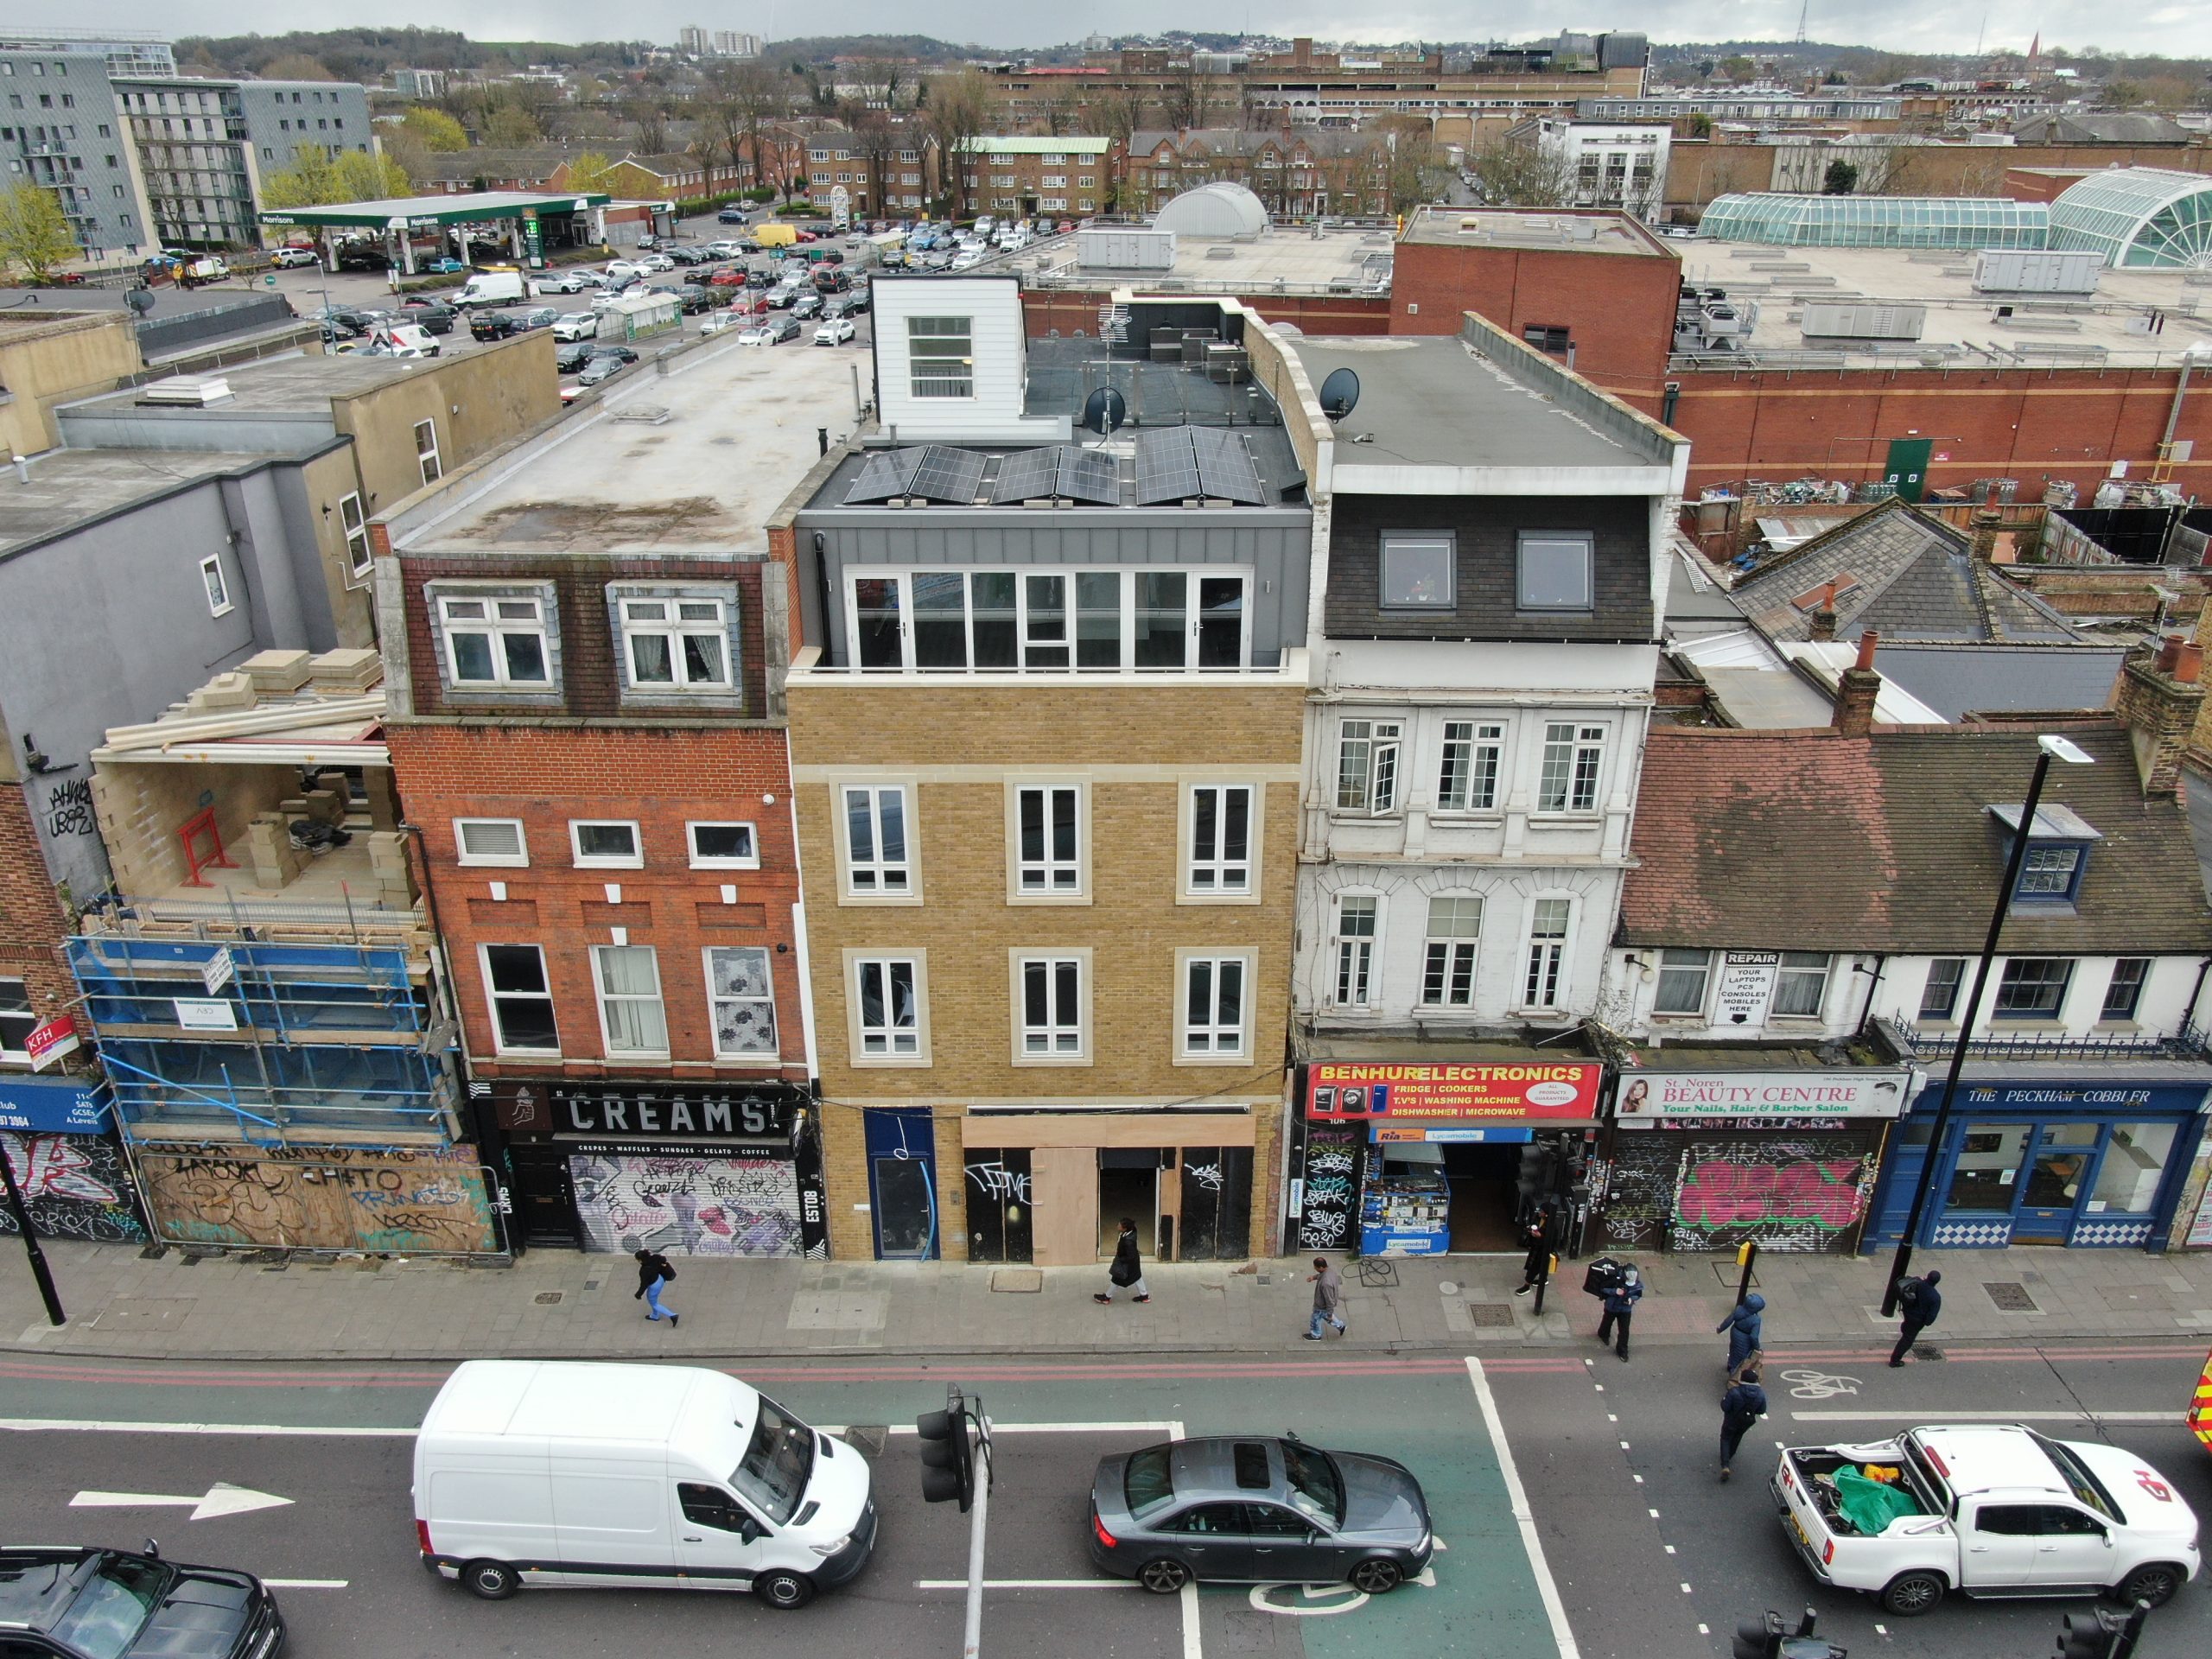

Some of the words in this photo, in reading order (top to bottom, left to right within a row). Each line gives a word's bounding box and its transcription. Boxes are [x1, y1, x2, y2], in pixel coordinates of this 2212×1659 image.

[410, 216, 438, 226] Morrisons
[1728, 954, 1777, 963] REPAIR
[28, 1028, 53, 1050] KFH
[1665, 1078, 1681, 1087] St.
[1686, 1078, 1724, 1087] Noren
[1662, 1088, 1758, 1102] BEAUTY
[1763, 1088, 1858, 1102] CENTRE
[1968, 1090, 1997, 1102] THE
[2005, 1090, 2074, 1102] PECKHAM
[0, 1101, 16, 1109] lub
[1694, 1104, 1726, 1113] Nails,
[569, 1092, 765, 1133] CREAMS
[1381, 1131, 1400, 1140] Ria
